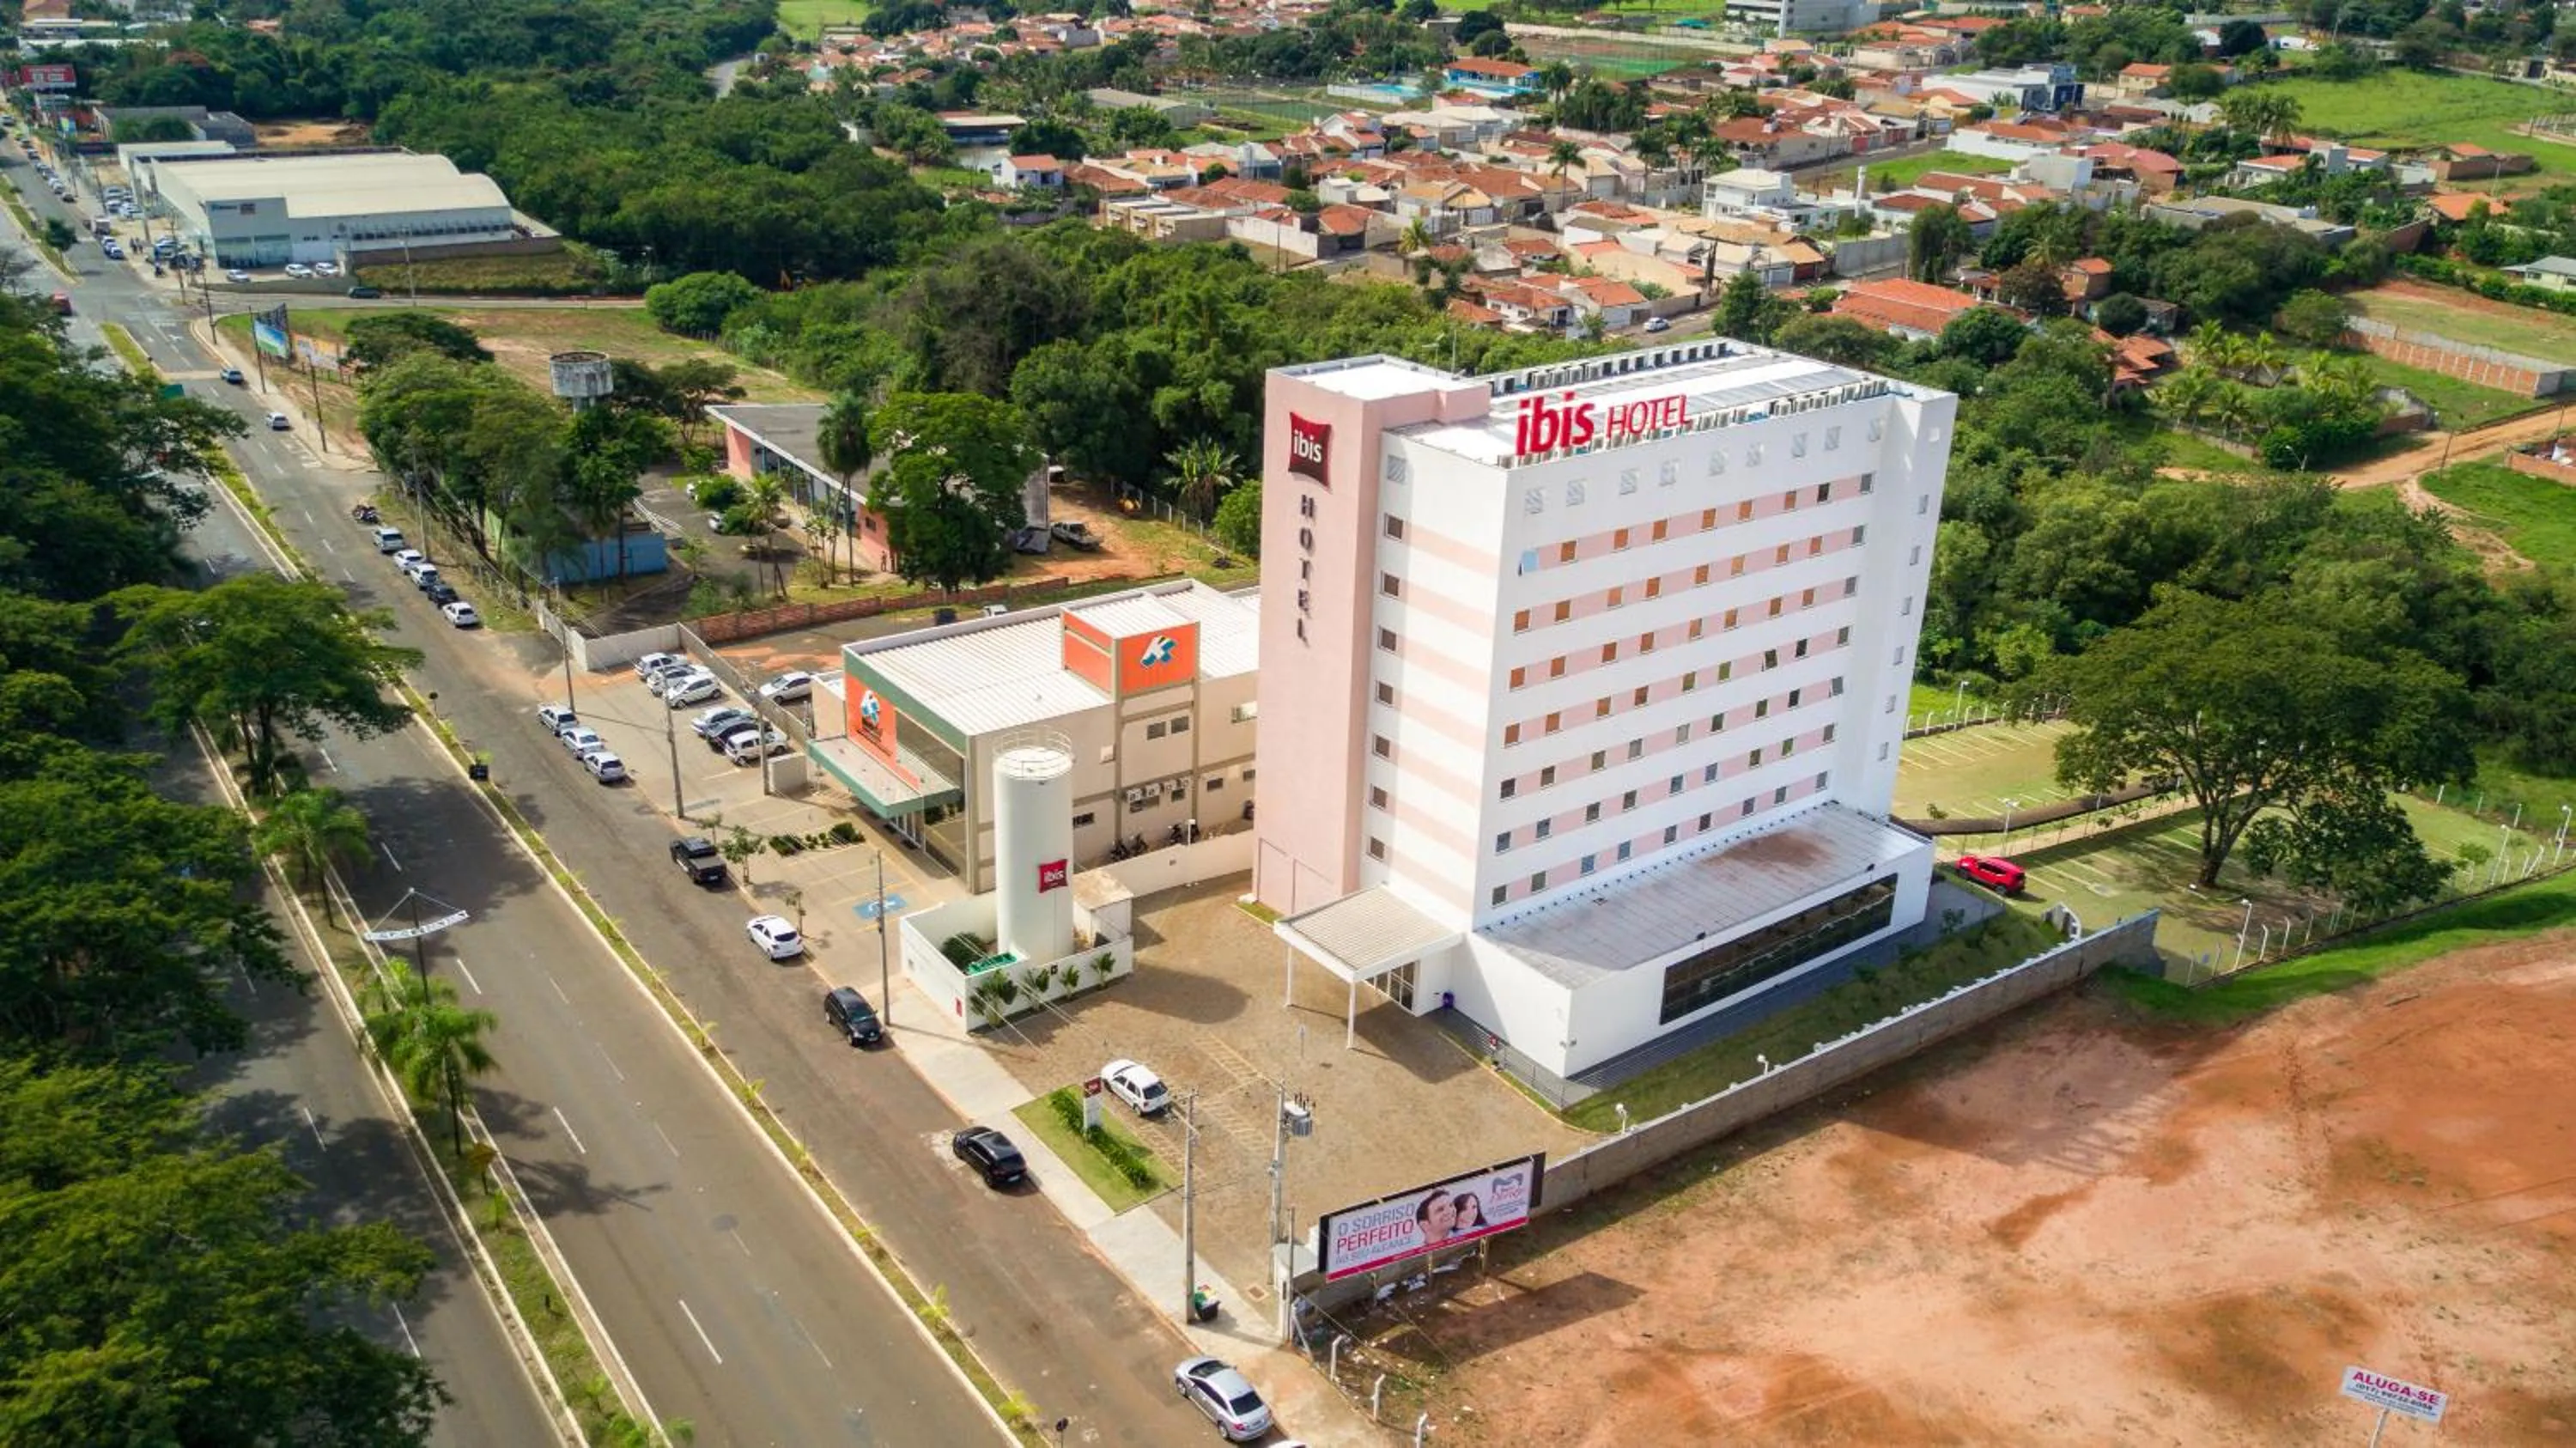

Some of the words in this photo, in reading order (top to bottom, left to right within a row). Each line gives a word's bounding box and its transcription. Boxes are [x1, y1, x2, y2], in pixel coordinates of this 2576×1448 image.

[1516, 391, 1595, 456] ibis
[1606, 394, 1692, 439] HOTEL
[1292, 429, 1323, 464] ibis
[1297, 494, 1314, 641] HOTEL
[1336, 1218, 1414, 1255] PERFEITO
[1339, 1222, 1348, 1237] O
[1352, 1202, 1415, 1233] SORRISO
[2353, 1372, 2439, 1406] ALUGA-SE
